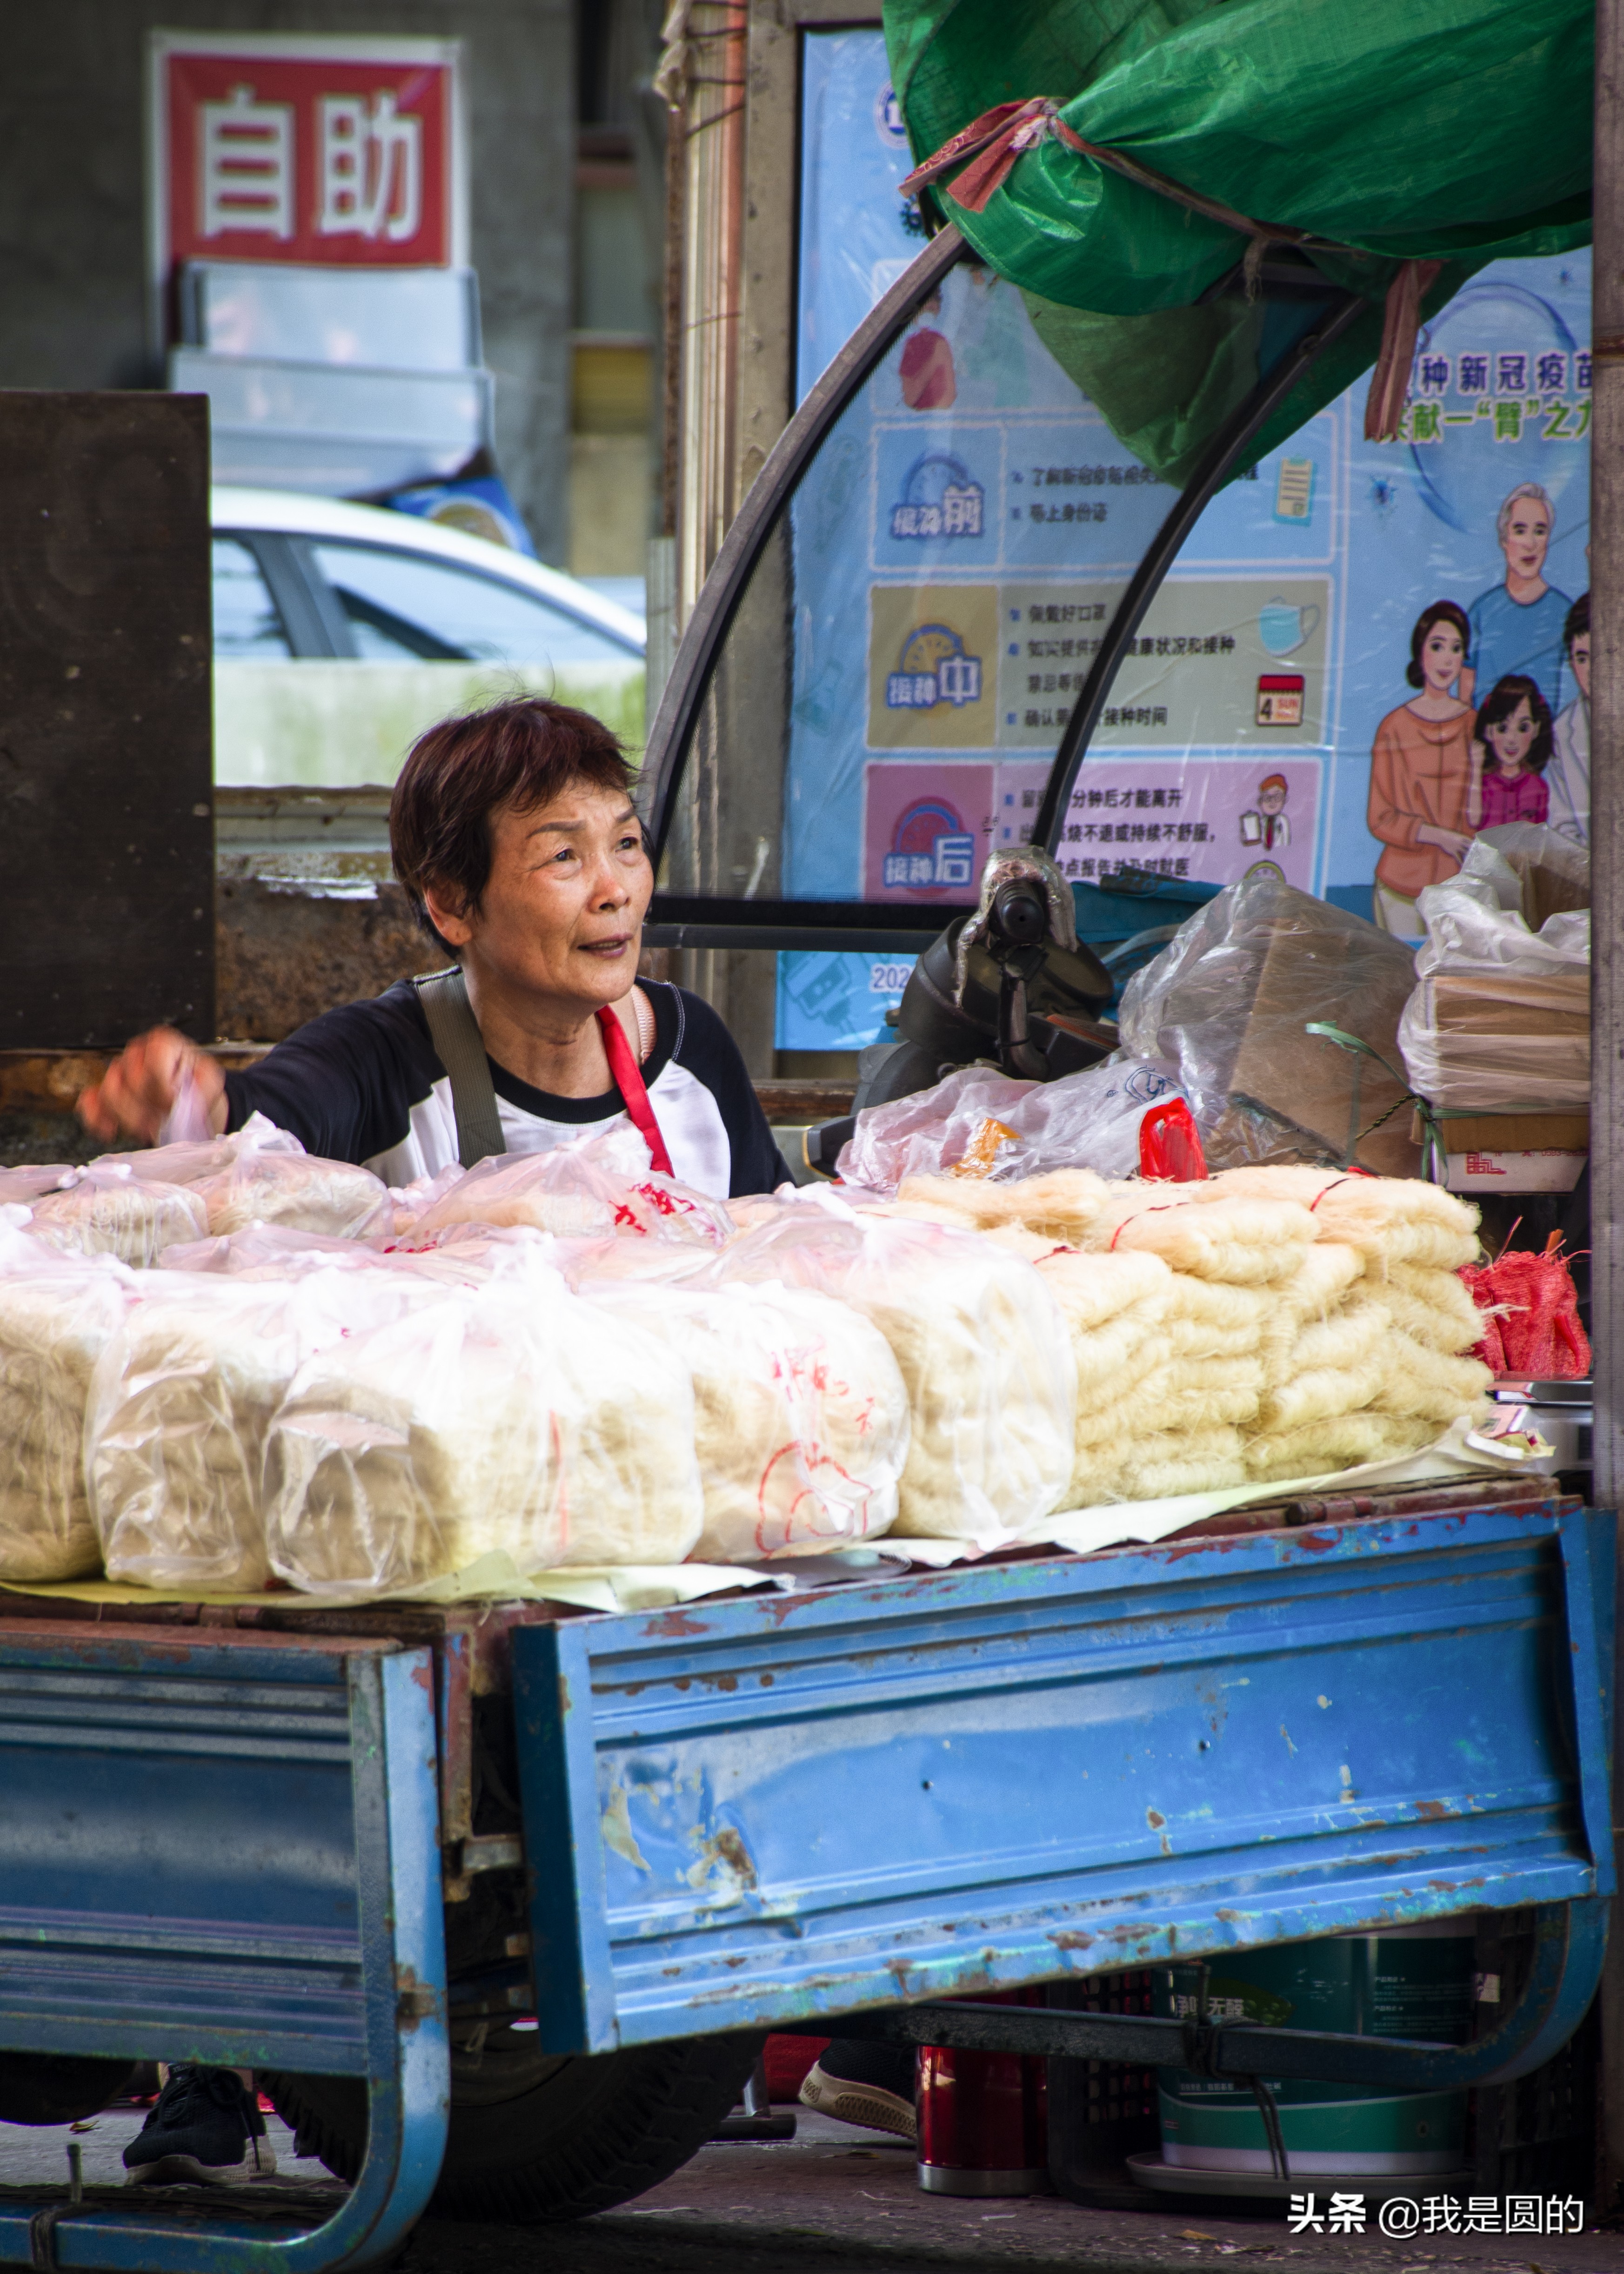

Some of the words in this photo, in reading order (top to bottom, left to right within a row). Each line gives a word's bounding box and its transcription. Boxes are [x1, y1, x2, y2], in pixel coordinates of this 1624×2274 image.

[198, 83, 424, 242] 自助
[889, 656, 979, 704] 接种中
[1025, 706, 1168, 727] 确认第接种时间
[1259, 697, 1272, 720] 4
[1023, 788, 1183, 809] 留分钟后才能离开
[885, 837, 971, 884] 接种后
